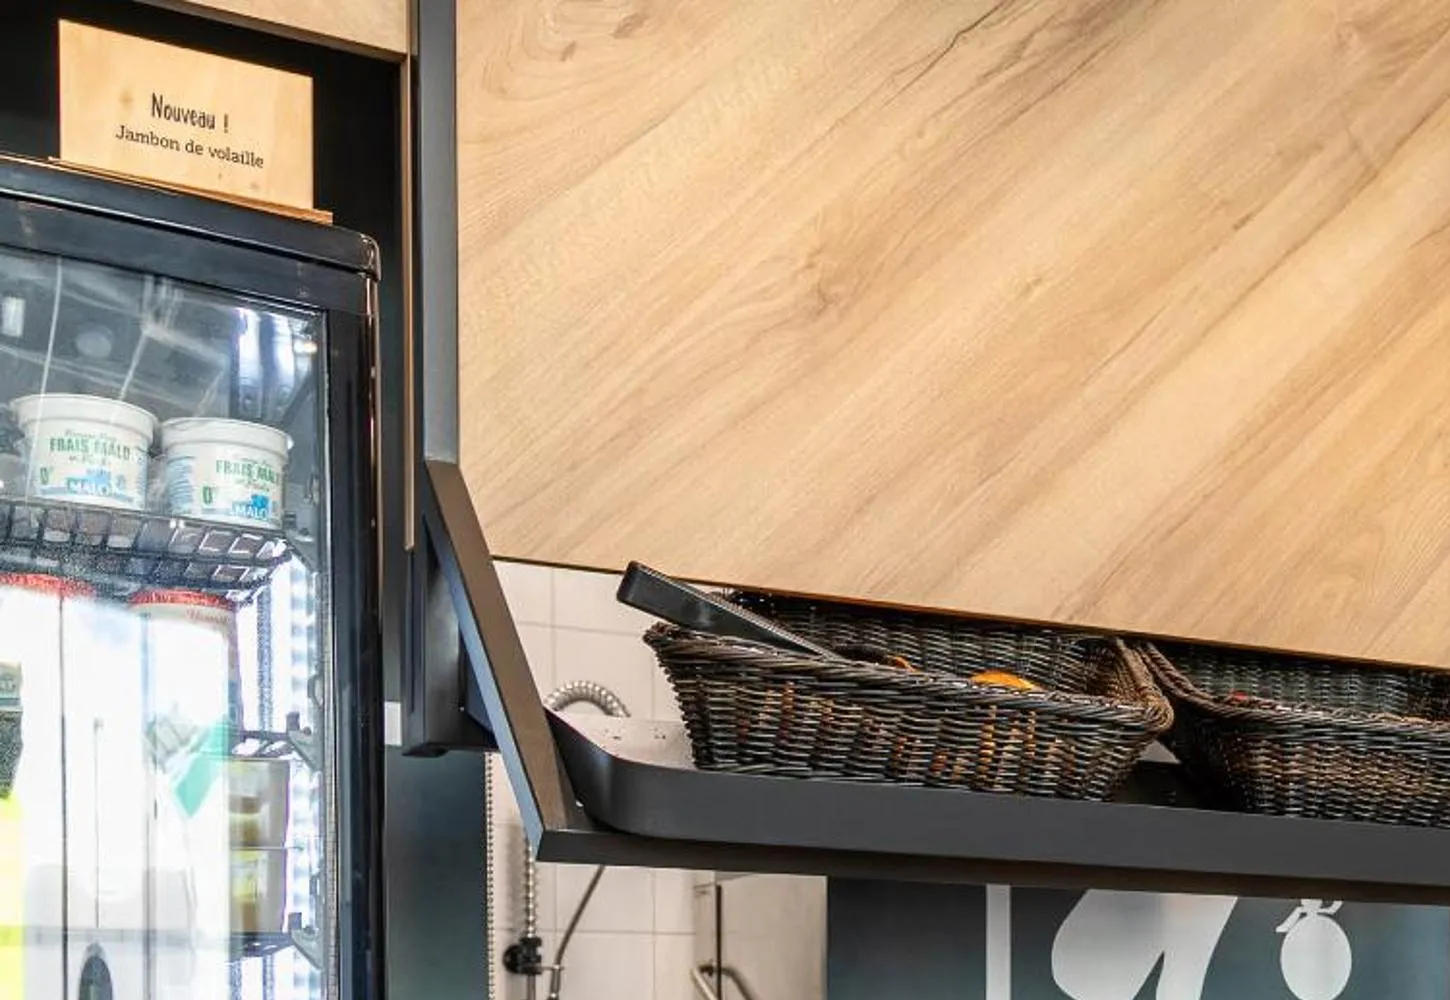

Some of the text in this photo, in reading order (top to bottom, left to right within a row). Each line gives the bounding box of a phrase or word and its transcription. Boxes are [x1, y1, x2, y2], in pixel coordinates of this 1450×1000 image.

[151, 92, 229, 134] Nouveau !
[116, 125, 264, 168] Jambon de volaille
